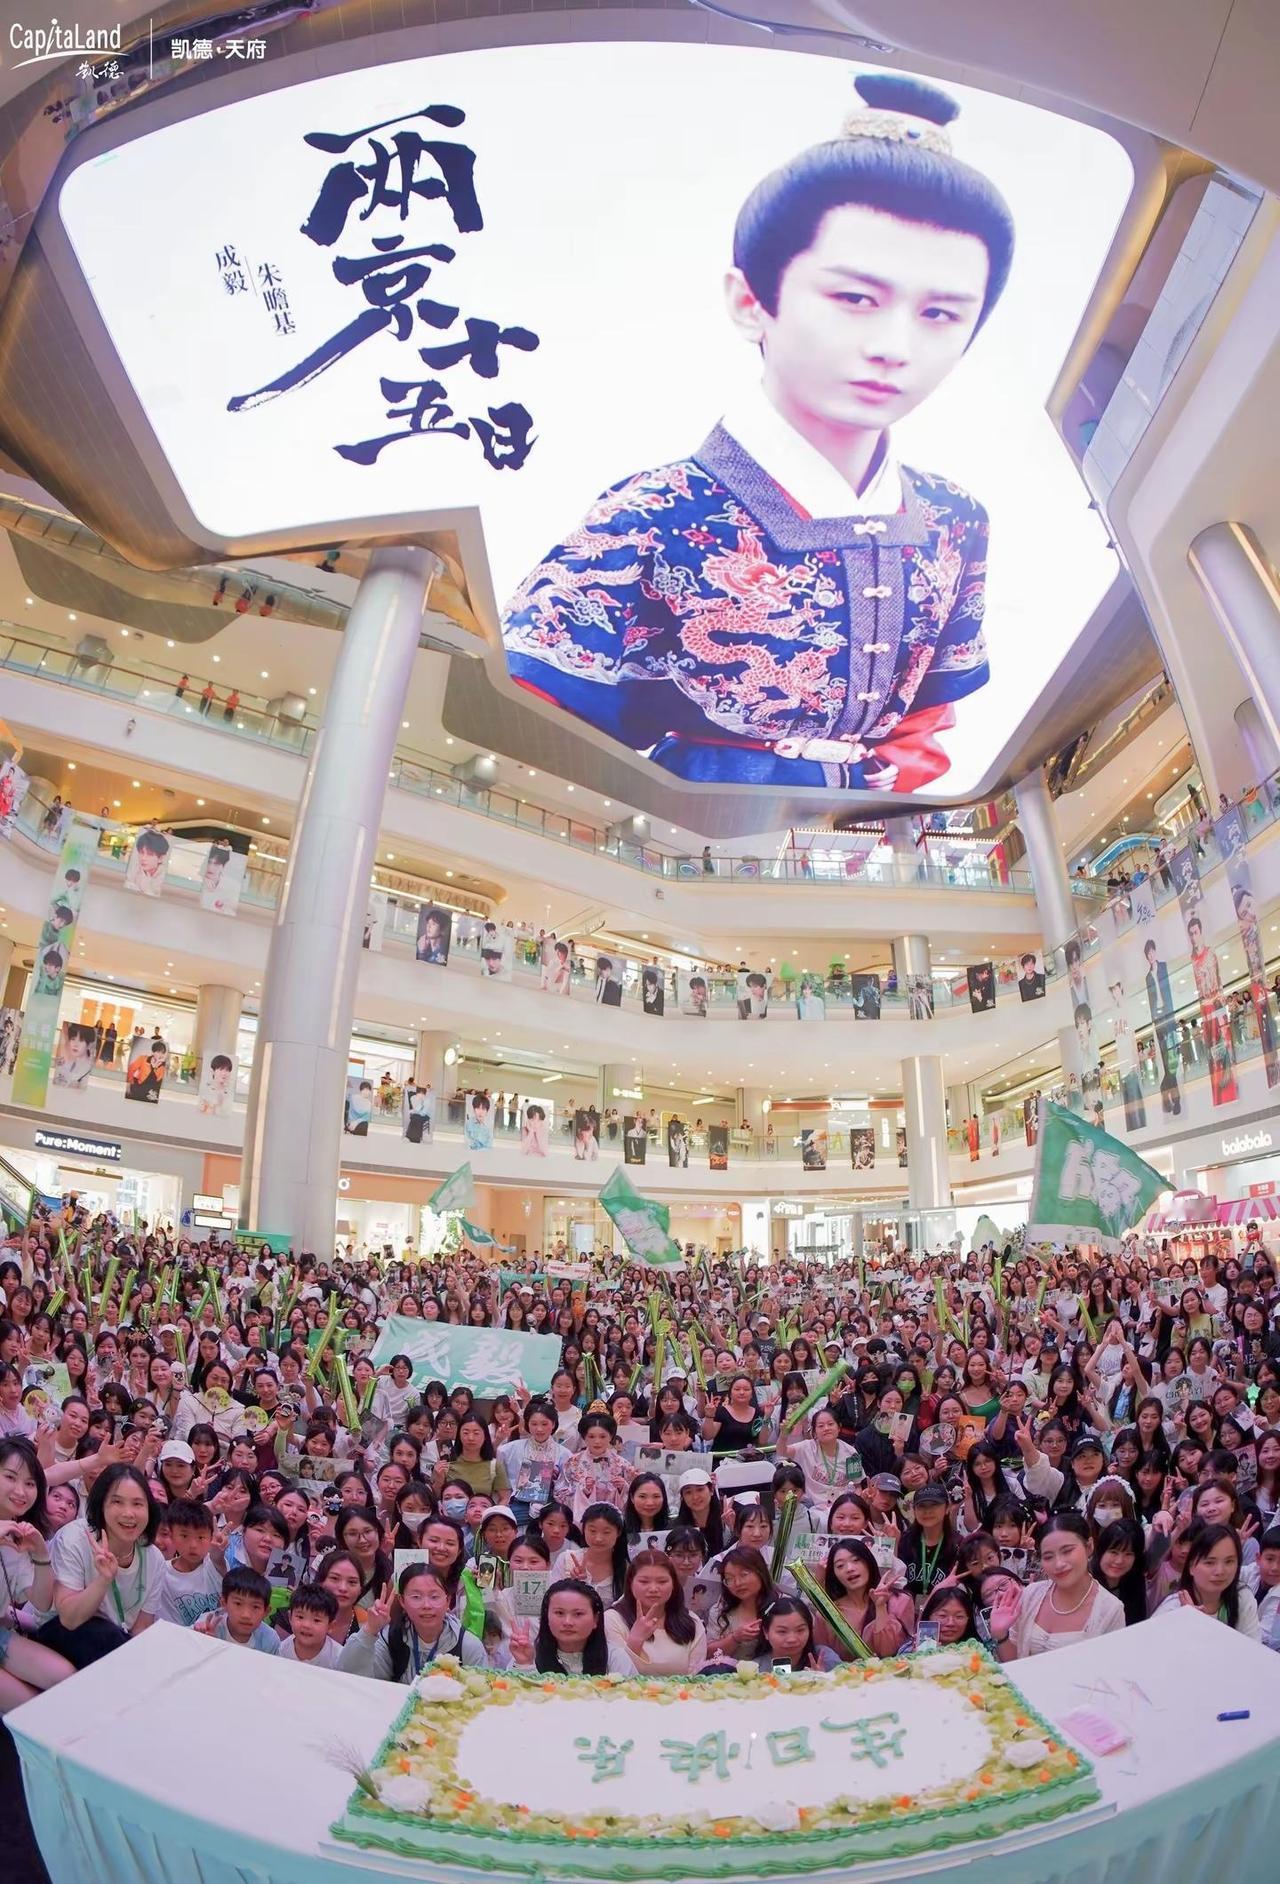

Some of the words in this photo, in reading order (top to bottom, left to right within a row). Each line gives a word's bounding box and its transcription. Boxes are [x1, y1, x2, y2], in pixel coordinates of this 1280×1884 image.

[215, 244, 248, 296] 成毅
[256, 263, 296, 337] 朱瞻基
[1221, 1129, 1273, 1156] balabala
[522, 1581, 541, 1595] 17
[573, 1711, 908, 1784] 生日快乐
